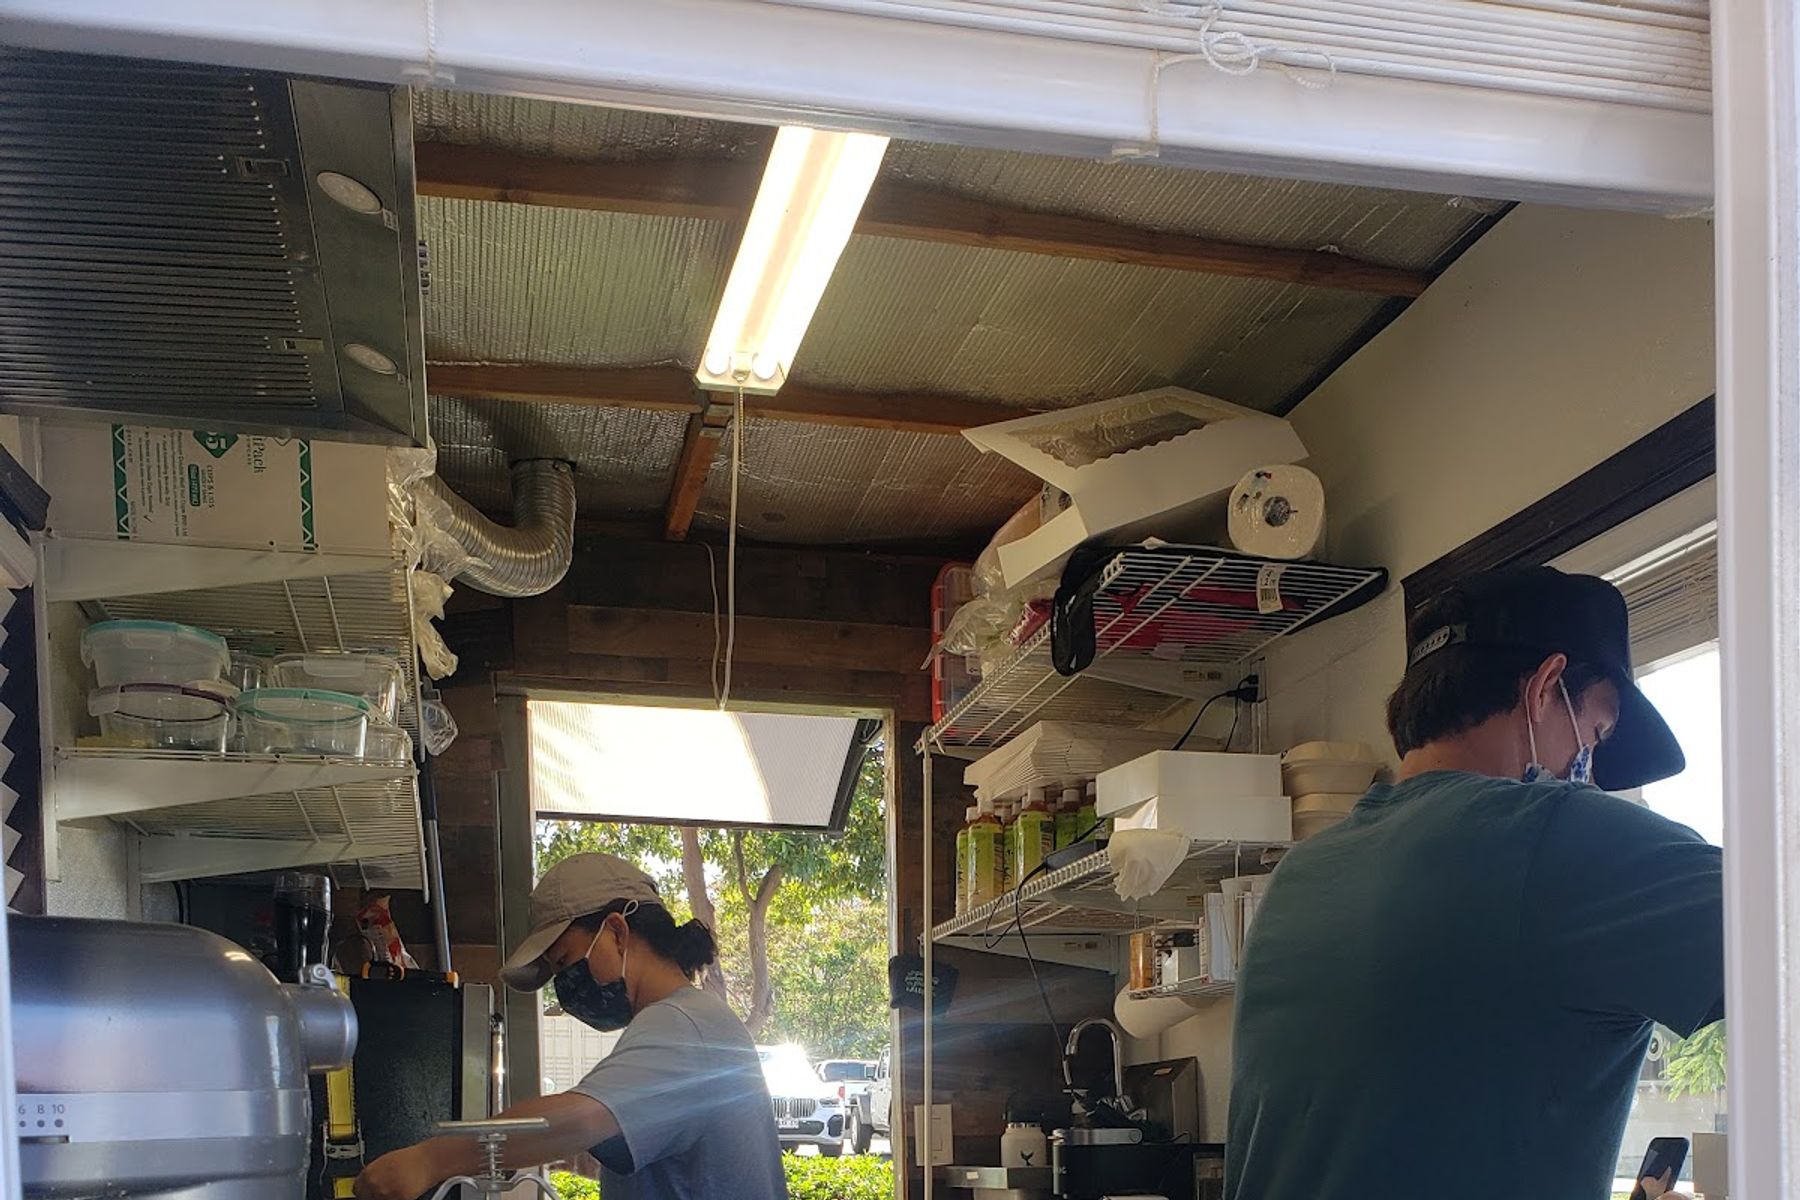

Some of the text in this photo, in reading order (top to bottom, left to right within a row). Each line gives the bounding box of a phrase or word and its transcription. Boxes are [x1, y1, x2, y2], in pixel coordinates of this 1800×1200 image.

[18, 1103, 65, 1115] 6 8 10
